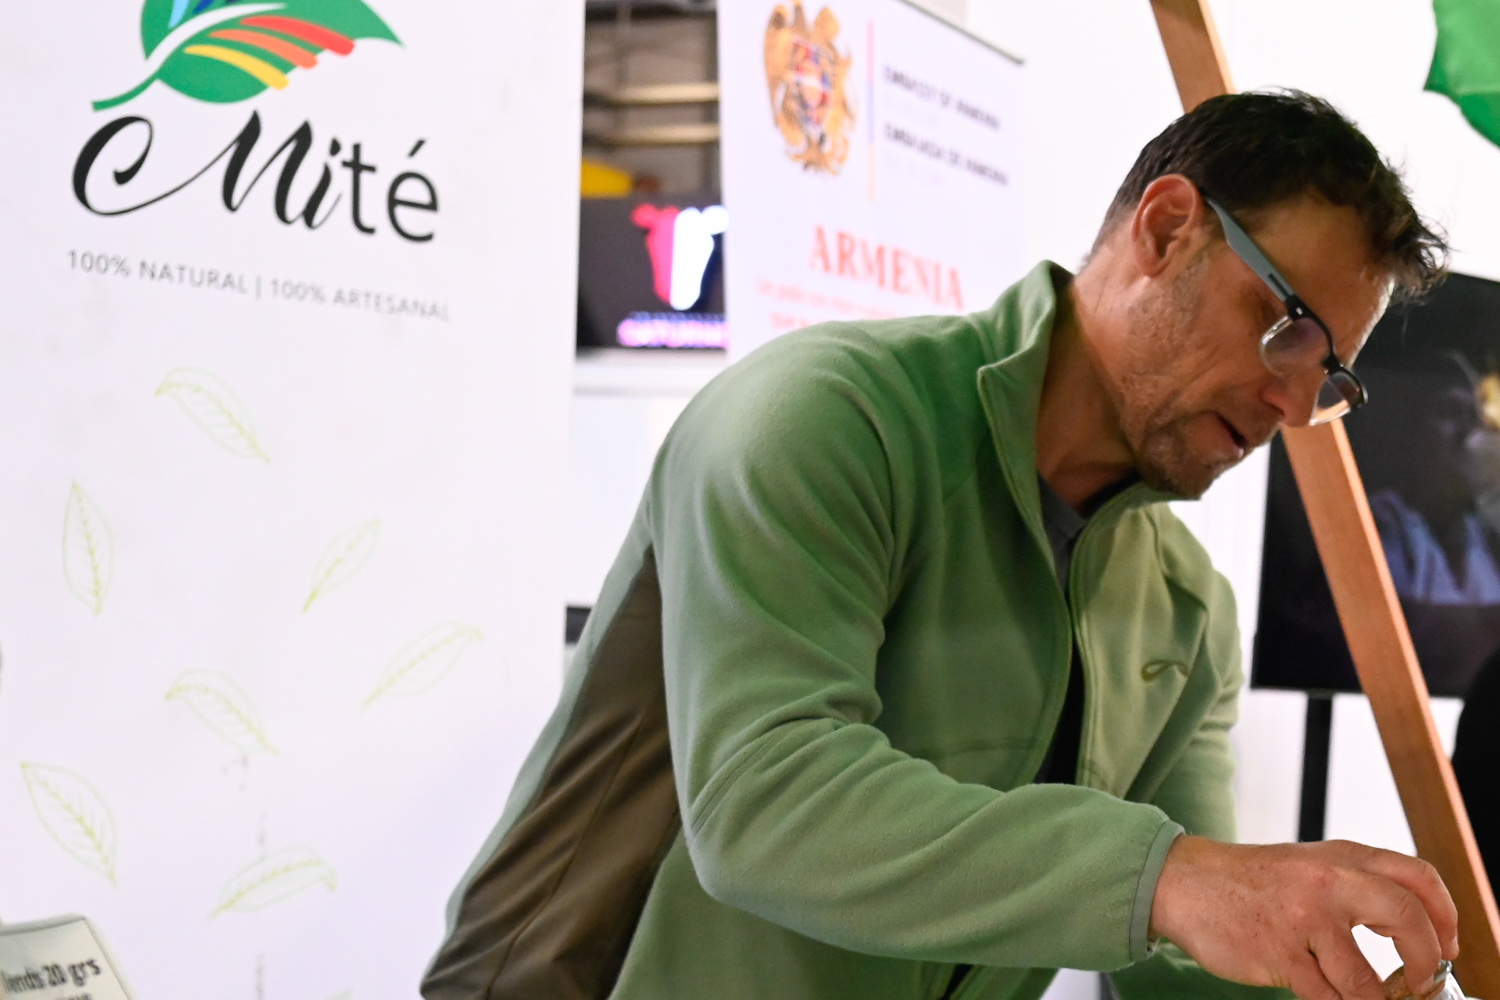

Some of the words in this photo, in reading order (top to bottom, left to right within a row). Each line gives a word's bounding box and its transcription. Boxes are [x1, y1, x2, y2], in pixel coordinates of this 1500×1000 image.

[71, 109, 440, 243] Mité
[67, 249, 131, 278] 100%
[138, 260, 249, 295] NATURAL
[269, 278, 326, 304] 100%
[332, 289, 452, 322] ARTESANAL
[810, 223, 964, 311] ARMENIA
[68, 957, 102, 987] grs
